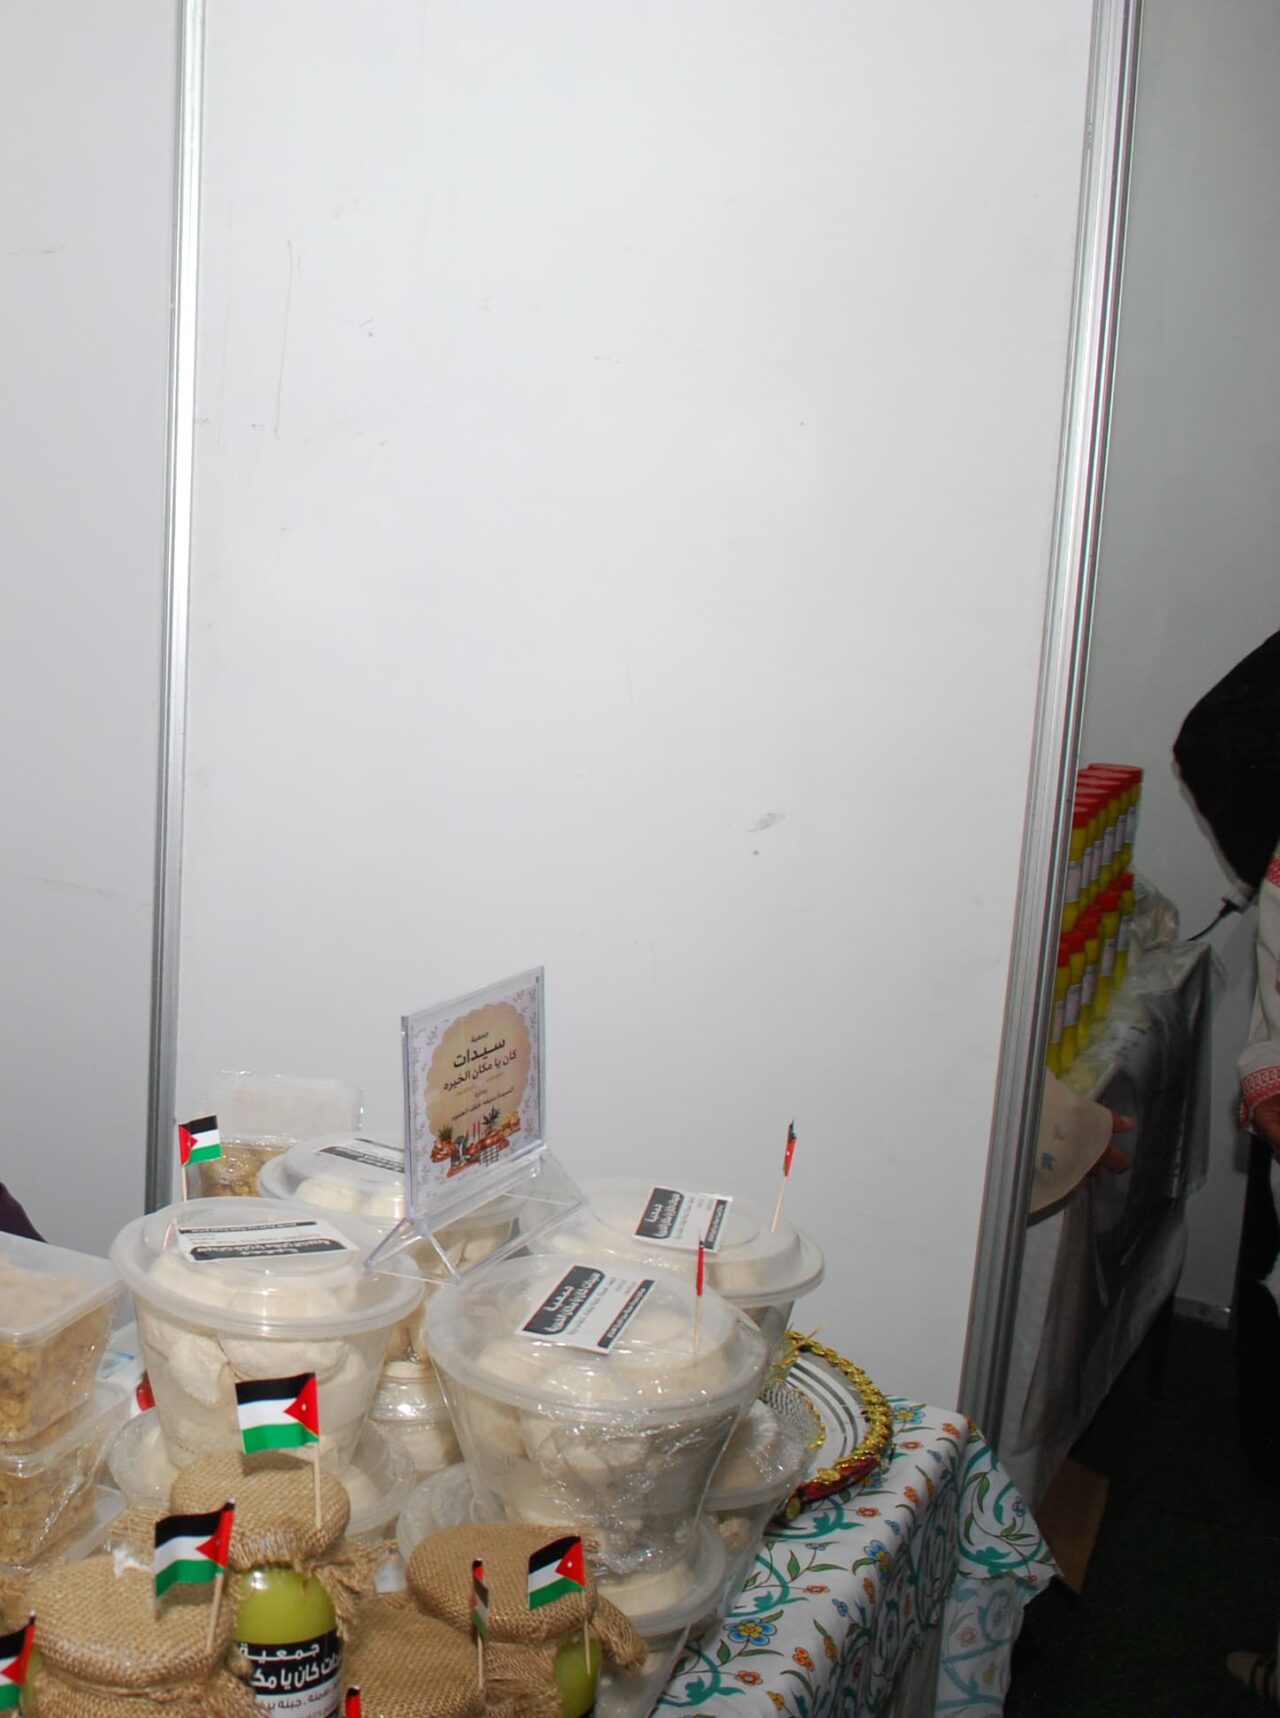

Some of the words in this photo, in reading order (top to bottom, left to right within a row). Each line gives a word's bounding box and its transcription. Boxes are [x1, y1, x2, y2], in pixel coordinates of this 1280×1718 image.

[453, 1039, 506, 1068] سيدات
[502, 1049, 517, 1066] كان
[472, 1062, 493, 1080] مكان
[239, 1642, 320, 1664] جمعية
[280, 1668, 292, 1690] يا
[294, 1662, 320, 1688] كان
